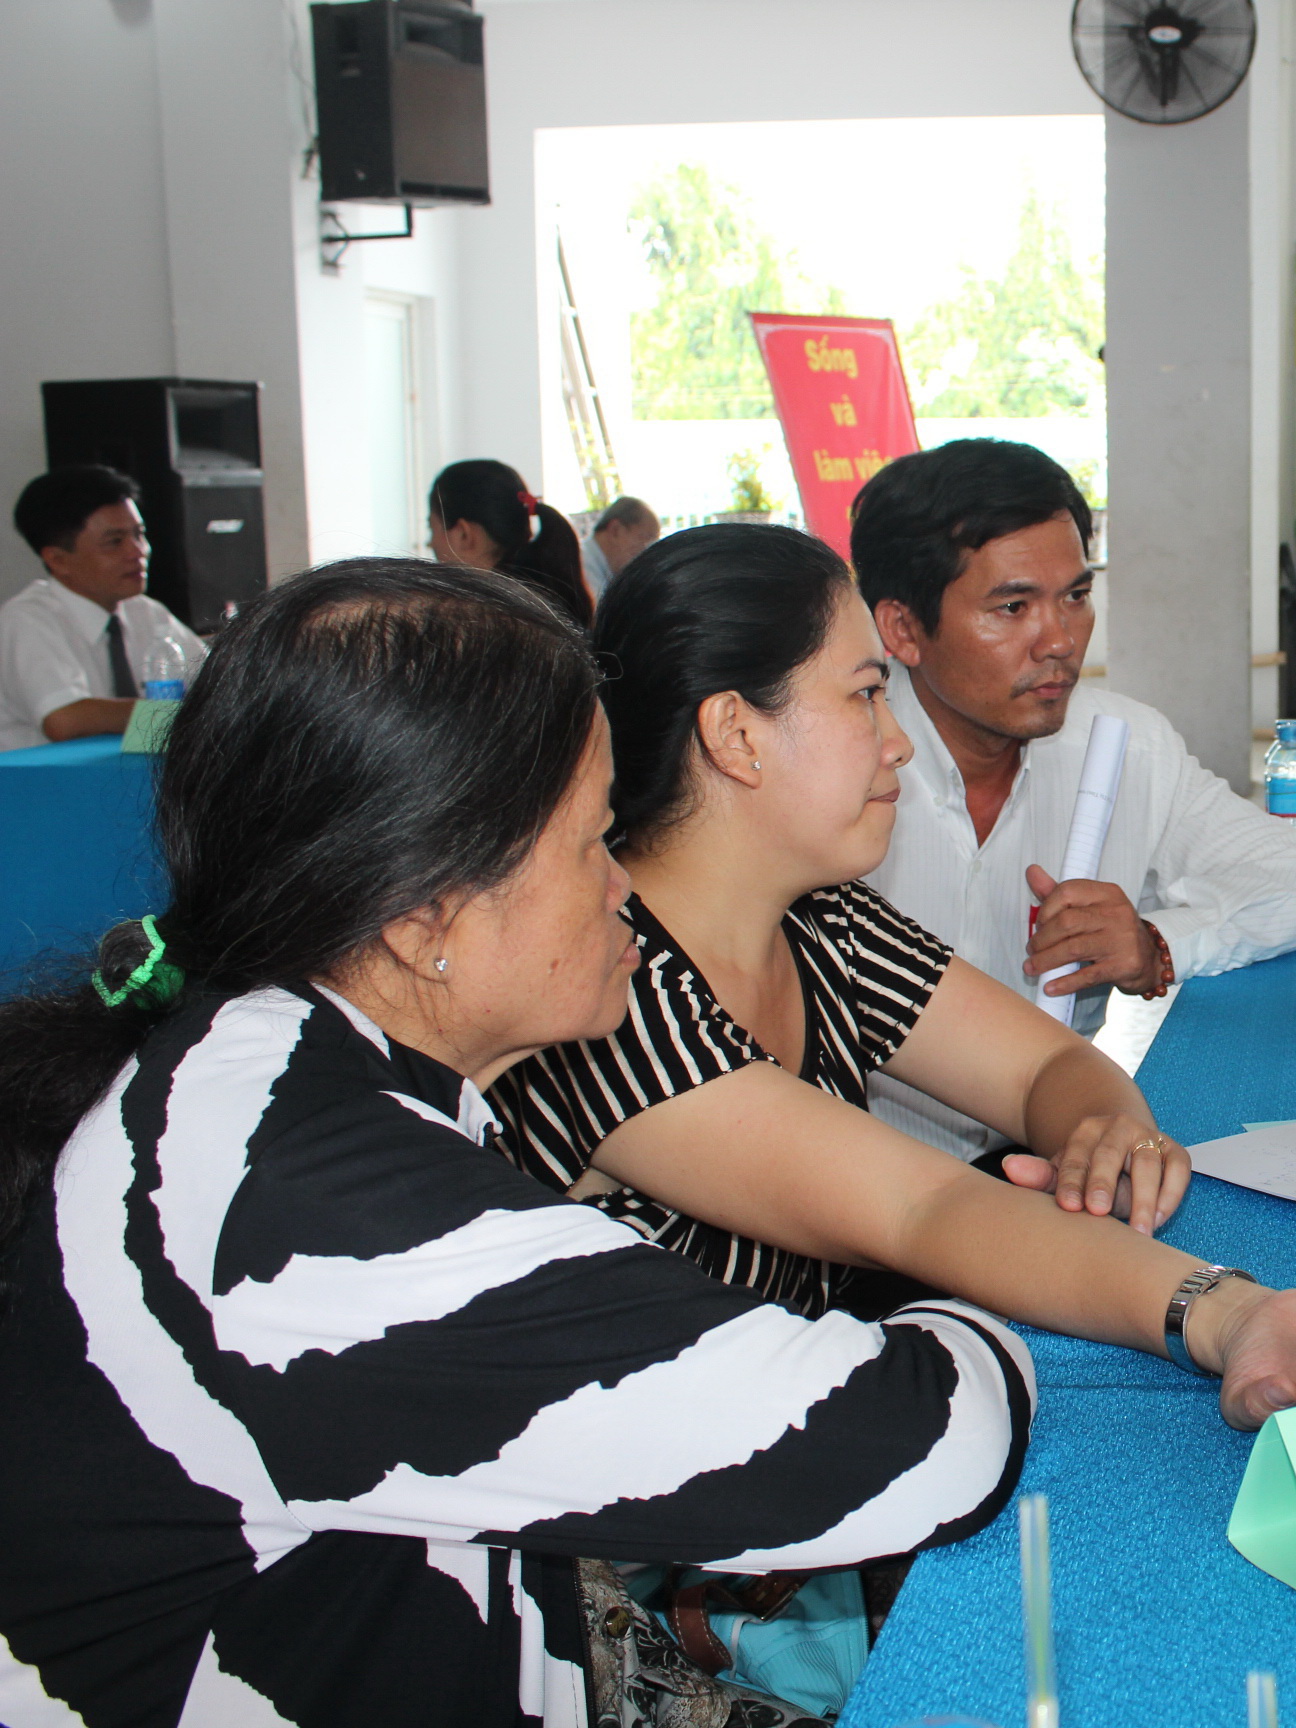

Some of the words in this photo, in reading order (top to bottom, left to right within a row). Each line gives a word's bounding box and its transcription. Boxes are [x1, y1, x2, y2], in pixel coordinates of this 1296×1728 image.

[804, 334, 858, 379] Sống
[829, 394, 858, 427] và
[812, 449, 855, 482] làm
